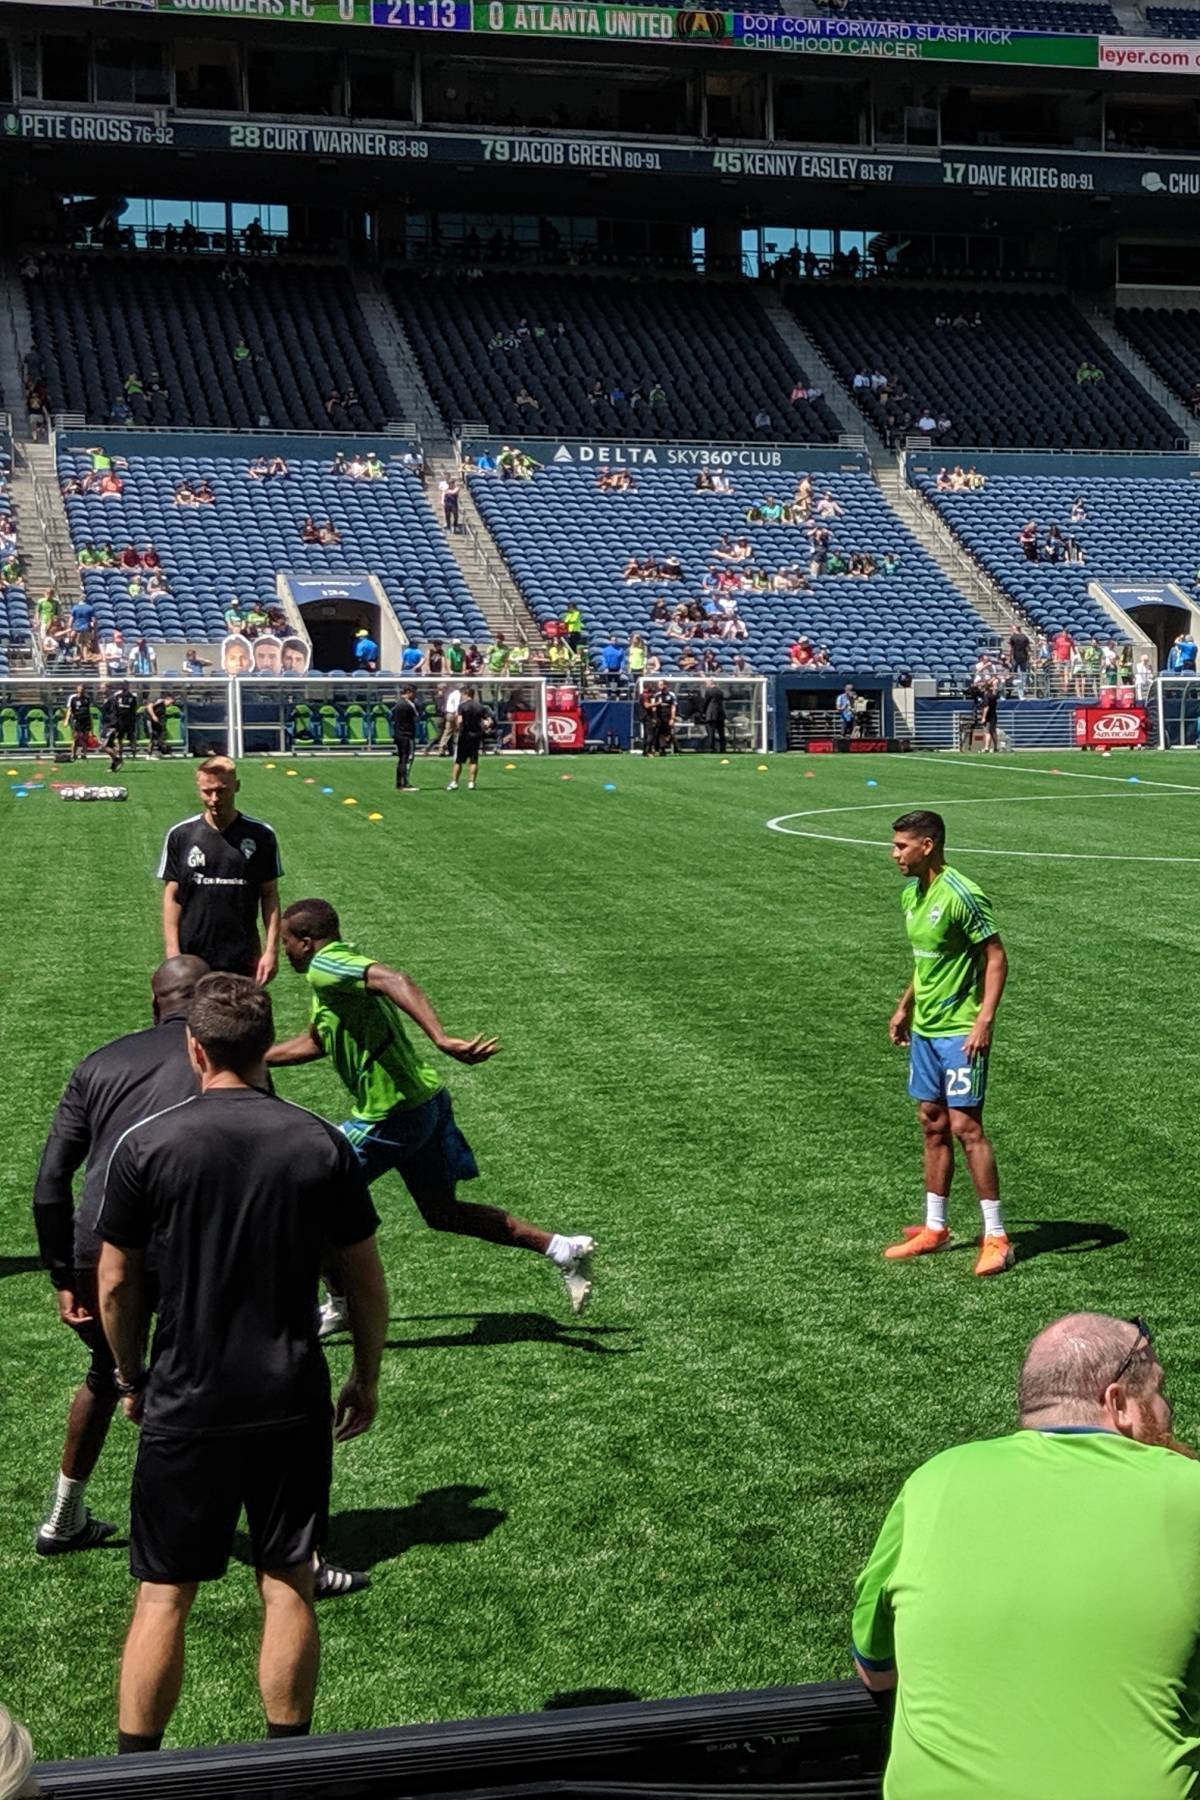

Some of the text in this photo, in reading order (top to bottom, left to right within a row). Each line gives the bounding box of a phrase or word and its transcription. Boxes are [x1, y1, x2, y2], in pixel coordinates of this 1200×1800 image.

[387, 0, 456, 28] 21:13
[488, 2, 504, 31] 0
[514, 5, 673, 39] ATLANTA UNITED
[743, 16, 1012, 46] DOT COM FORWARD SLASH KICK
[743, 33, 922, 58] CHILDHOOD CANCER!
[21, 114, 174, 144] PETE GROSS 76-92
[230, 126, 428, 158] 28 CURT WARNER 83-89
[481, 139, 661, 170] 79 JACOB GREEN 80-91
[713, 153, 893, 181] 45 KENNY EASLEY 81-87
[943, 163, 1094, 190] 17 DAVE KRIEG 80-91
[580, 446, 657, 463] DELTA
[187, 854, 206, 867] GM
[946, 1067, 971, 1096] 25
